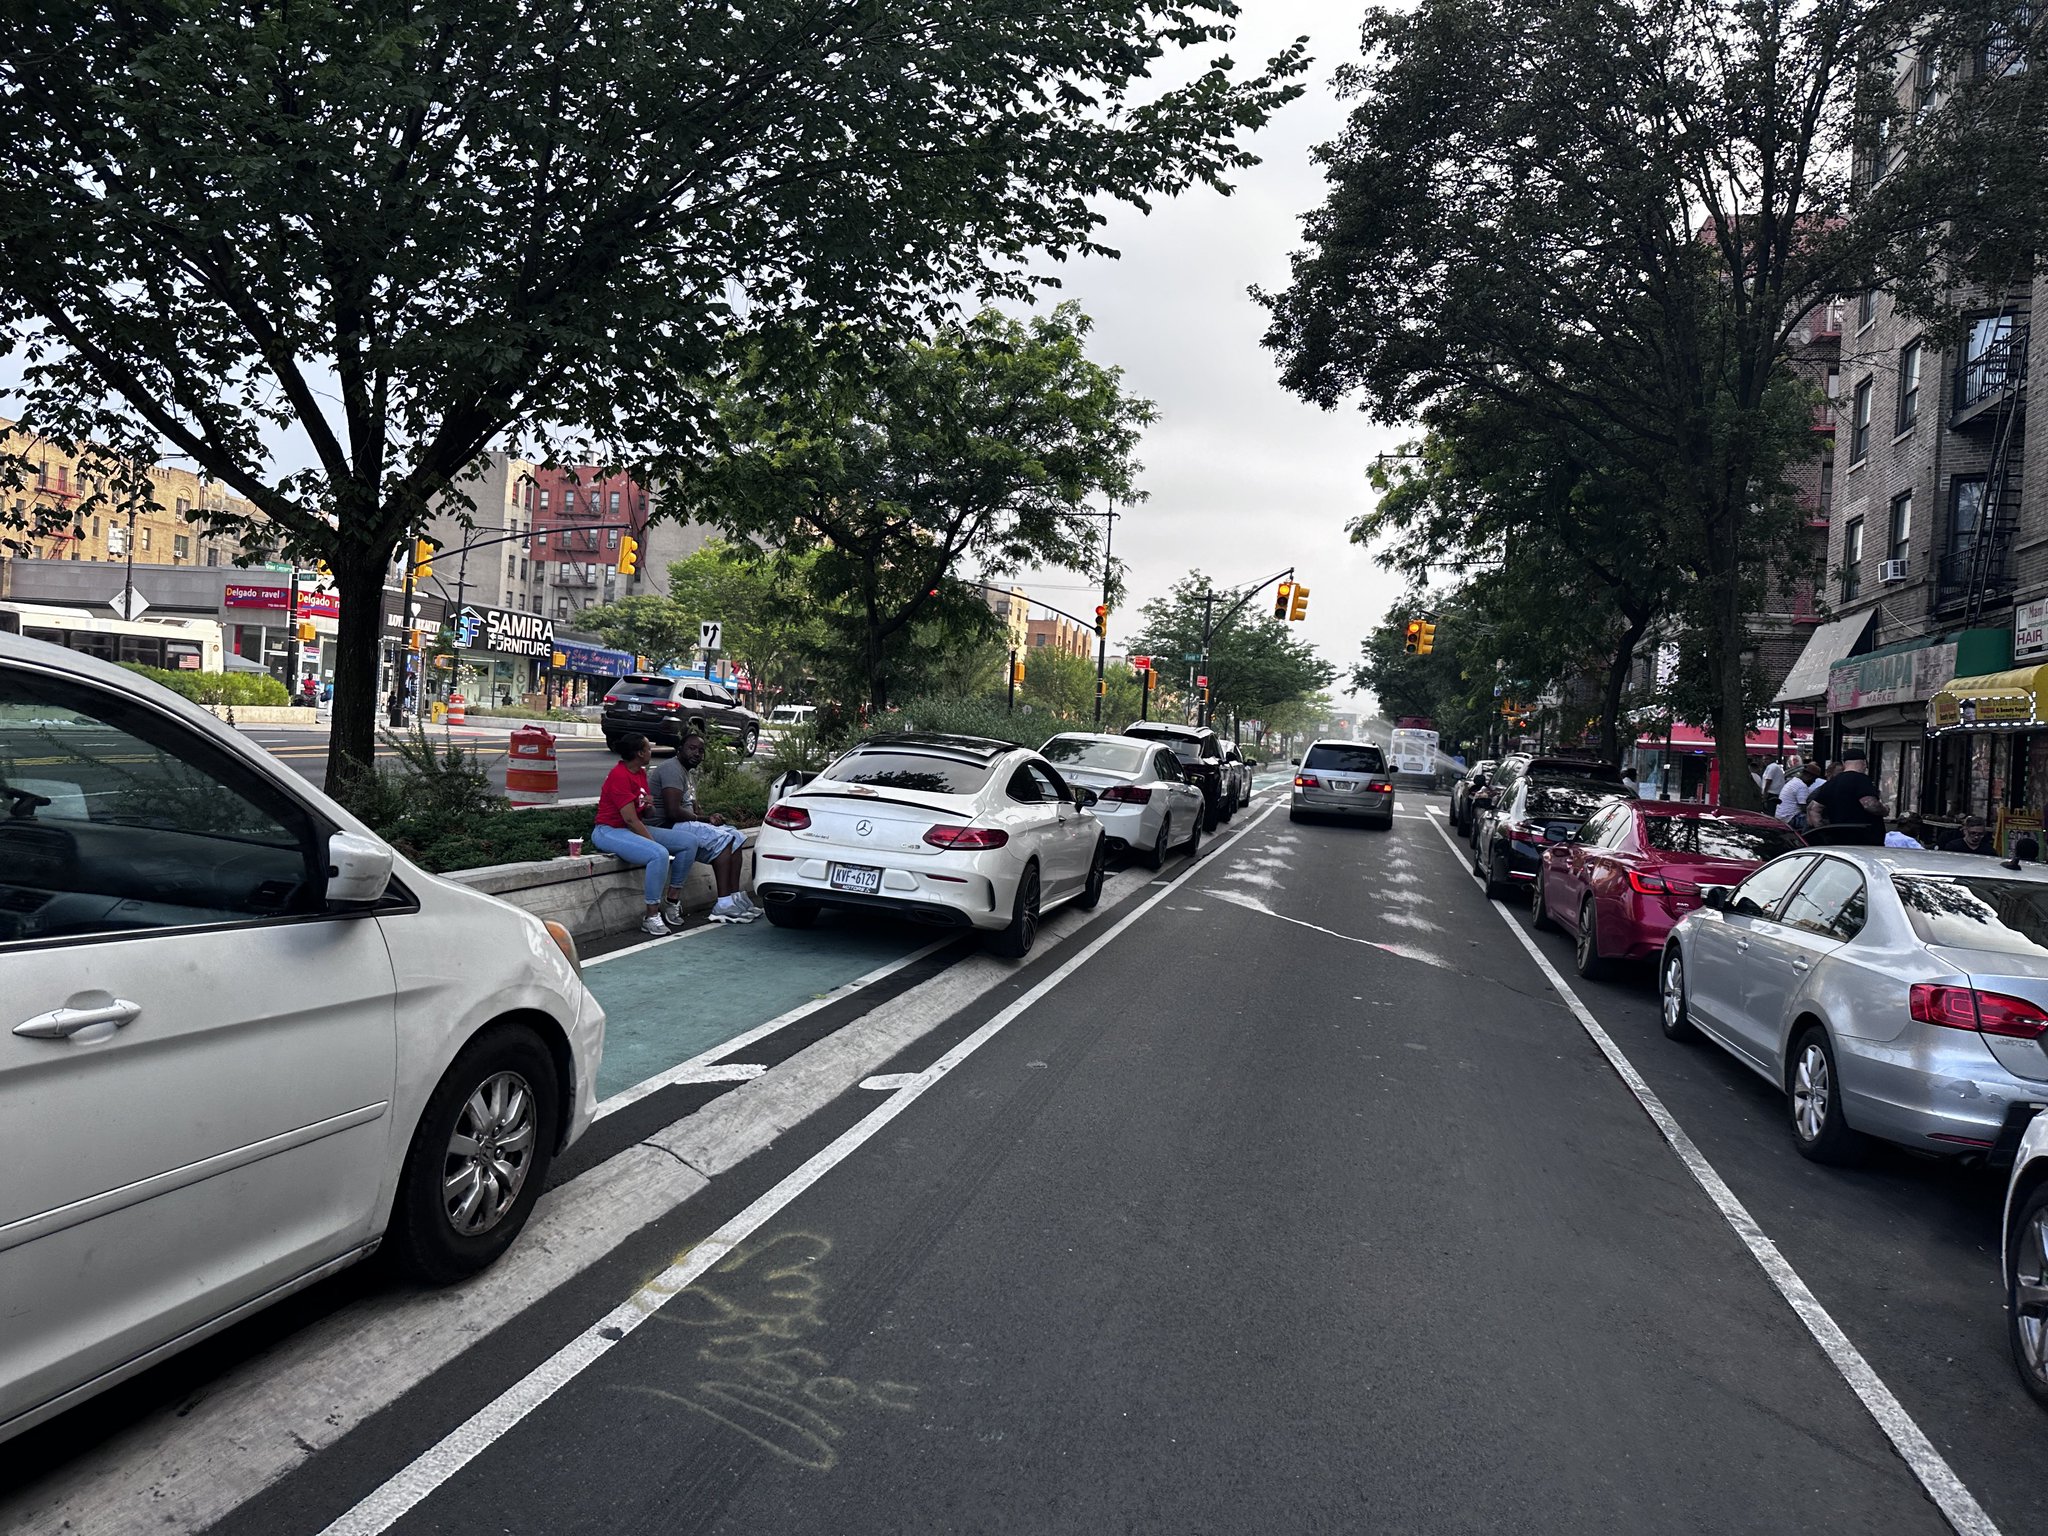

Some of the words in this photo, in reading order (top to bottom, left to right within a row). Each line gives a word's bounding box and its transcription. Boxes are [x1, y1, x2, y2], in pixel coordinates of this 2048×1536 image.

[226, 587, 257, 599] Delgado
[298, 592, 330, 607] Delgado
[486, 610, 554, 641] SAMIRA
[2017, 629, 2043, 646] HAIR
[487, 638, 551, 657] FURNITURE
[1866, 690, 1896, 703] MARKET
